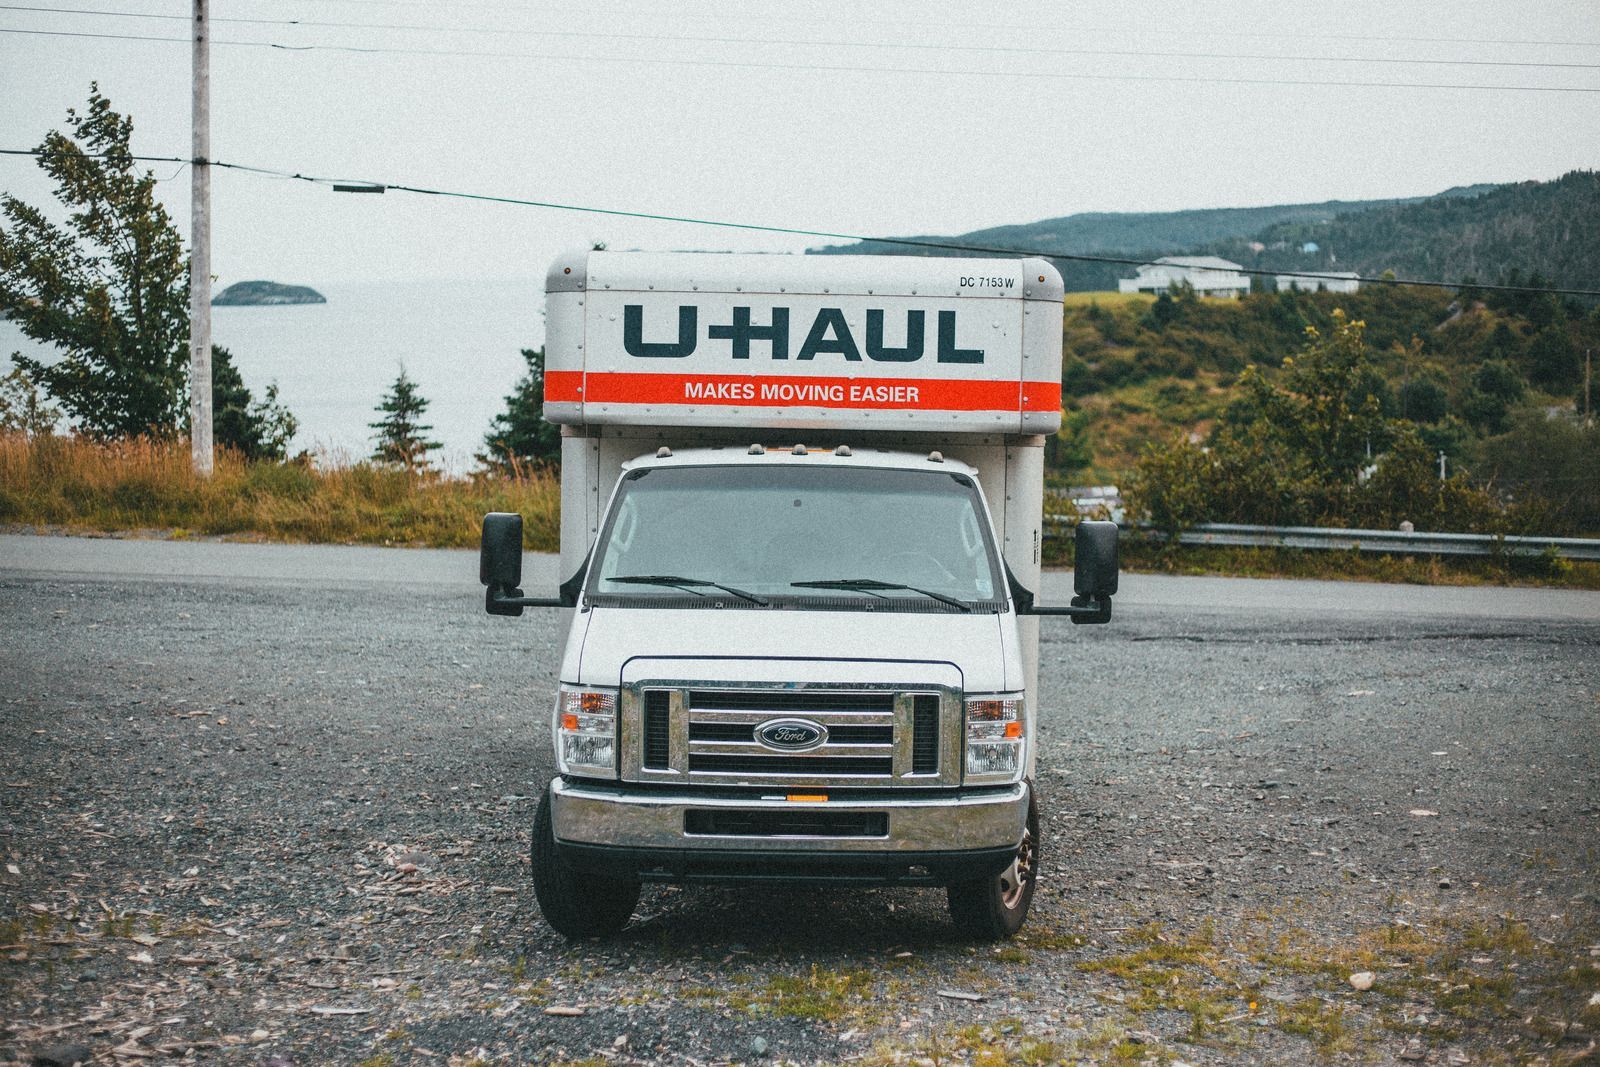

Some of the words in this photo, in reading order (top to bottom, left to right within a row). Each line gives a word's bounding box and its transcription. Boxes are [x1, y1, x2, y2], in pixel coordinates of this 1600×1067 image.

[960, 276, 975, 288] DC
[979, 277, 1015, 289] 7153W
[623, 304, 985, 364] U-HAUL
[684, 382, 755, 400] MAKES
[760, 384, 844, 402] MOVING
[850, 386, 920, 403] EASIER
[774, 726, 806, 741] Ford
